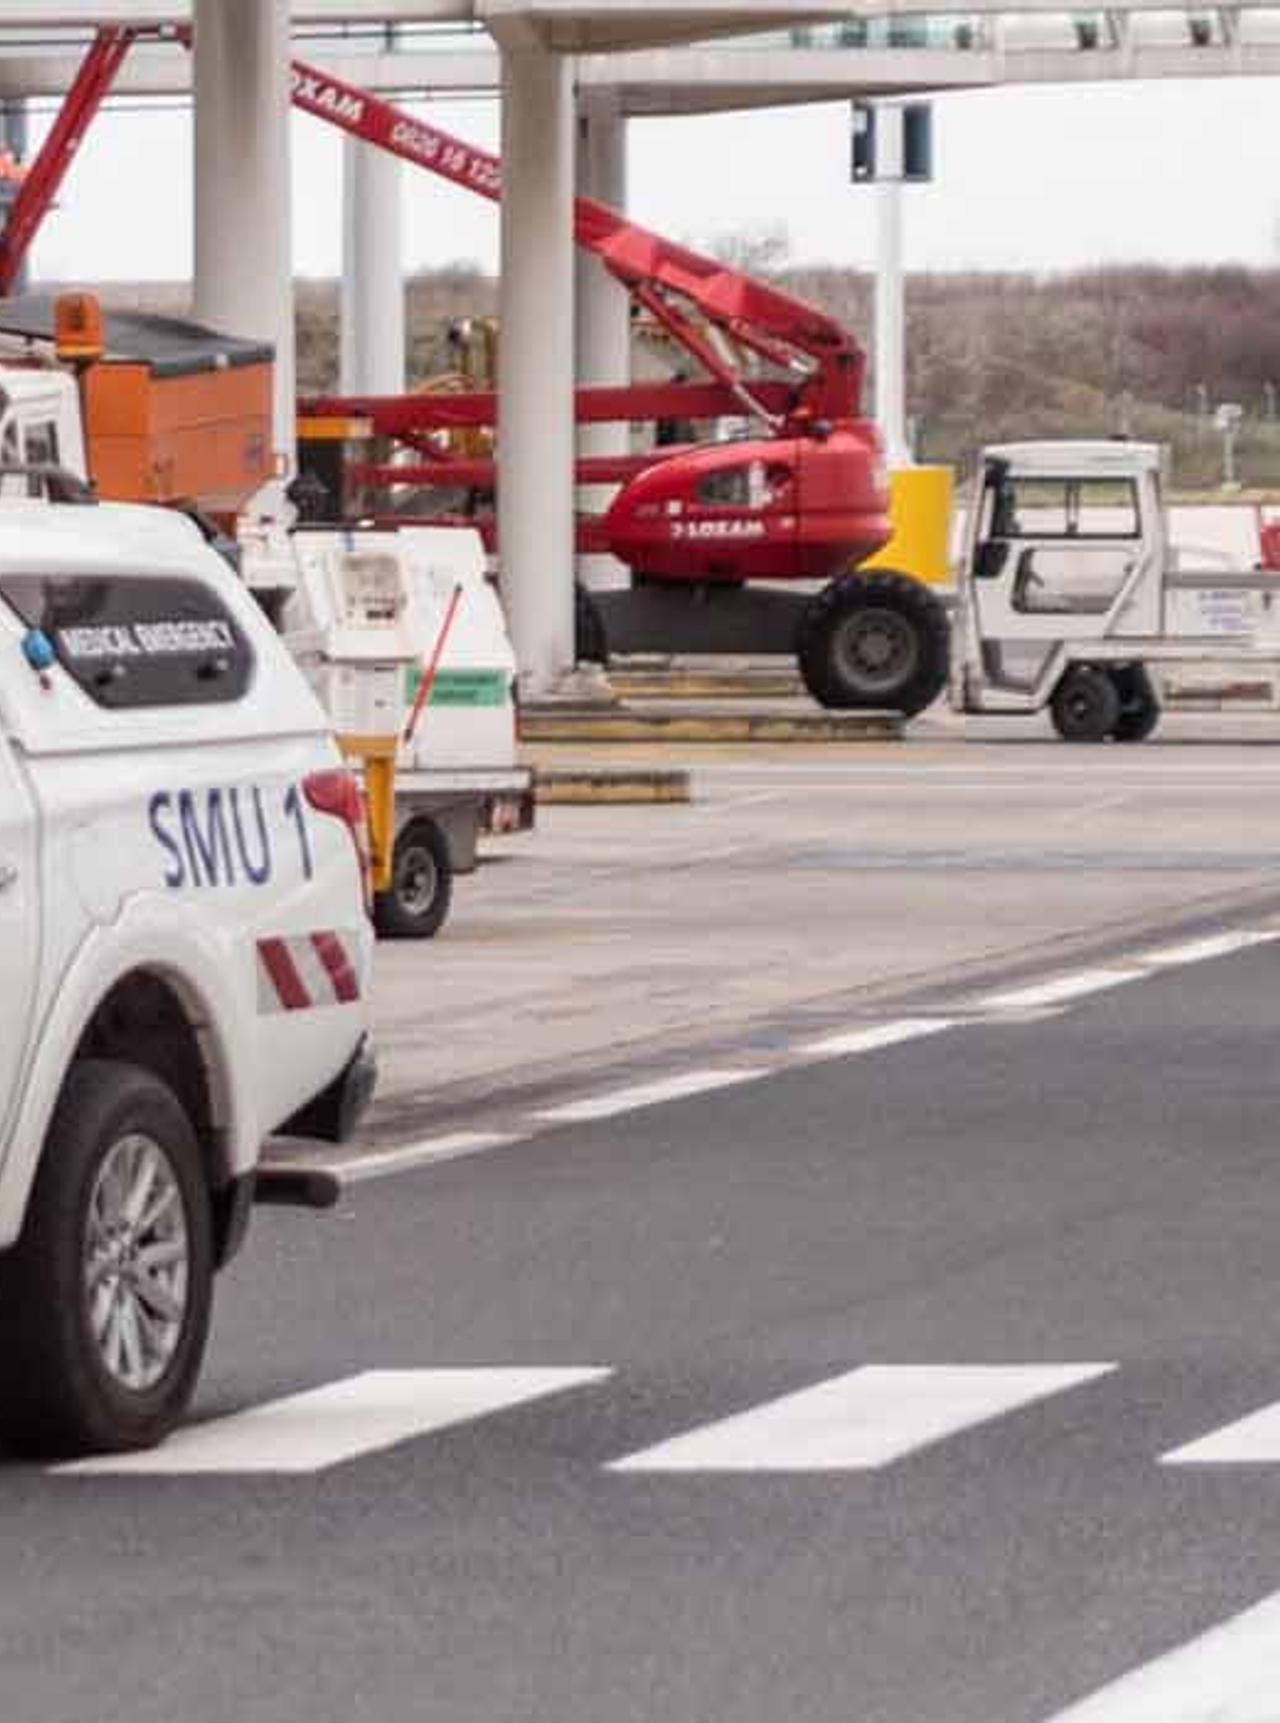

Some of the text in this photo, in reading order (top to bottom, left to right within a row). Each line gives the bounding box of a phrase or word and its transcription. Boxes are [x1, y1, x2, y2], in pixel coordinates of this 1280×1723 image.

[291, 71, 364, 125] OXAM
[58, 621, 238, 656] MEDICAL EMERGENCY
[149, 784, 313, 888] SMU 1
